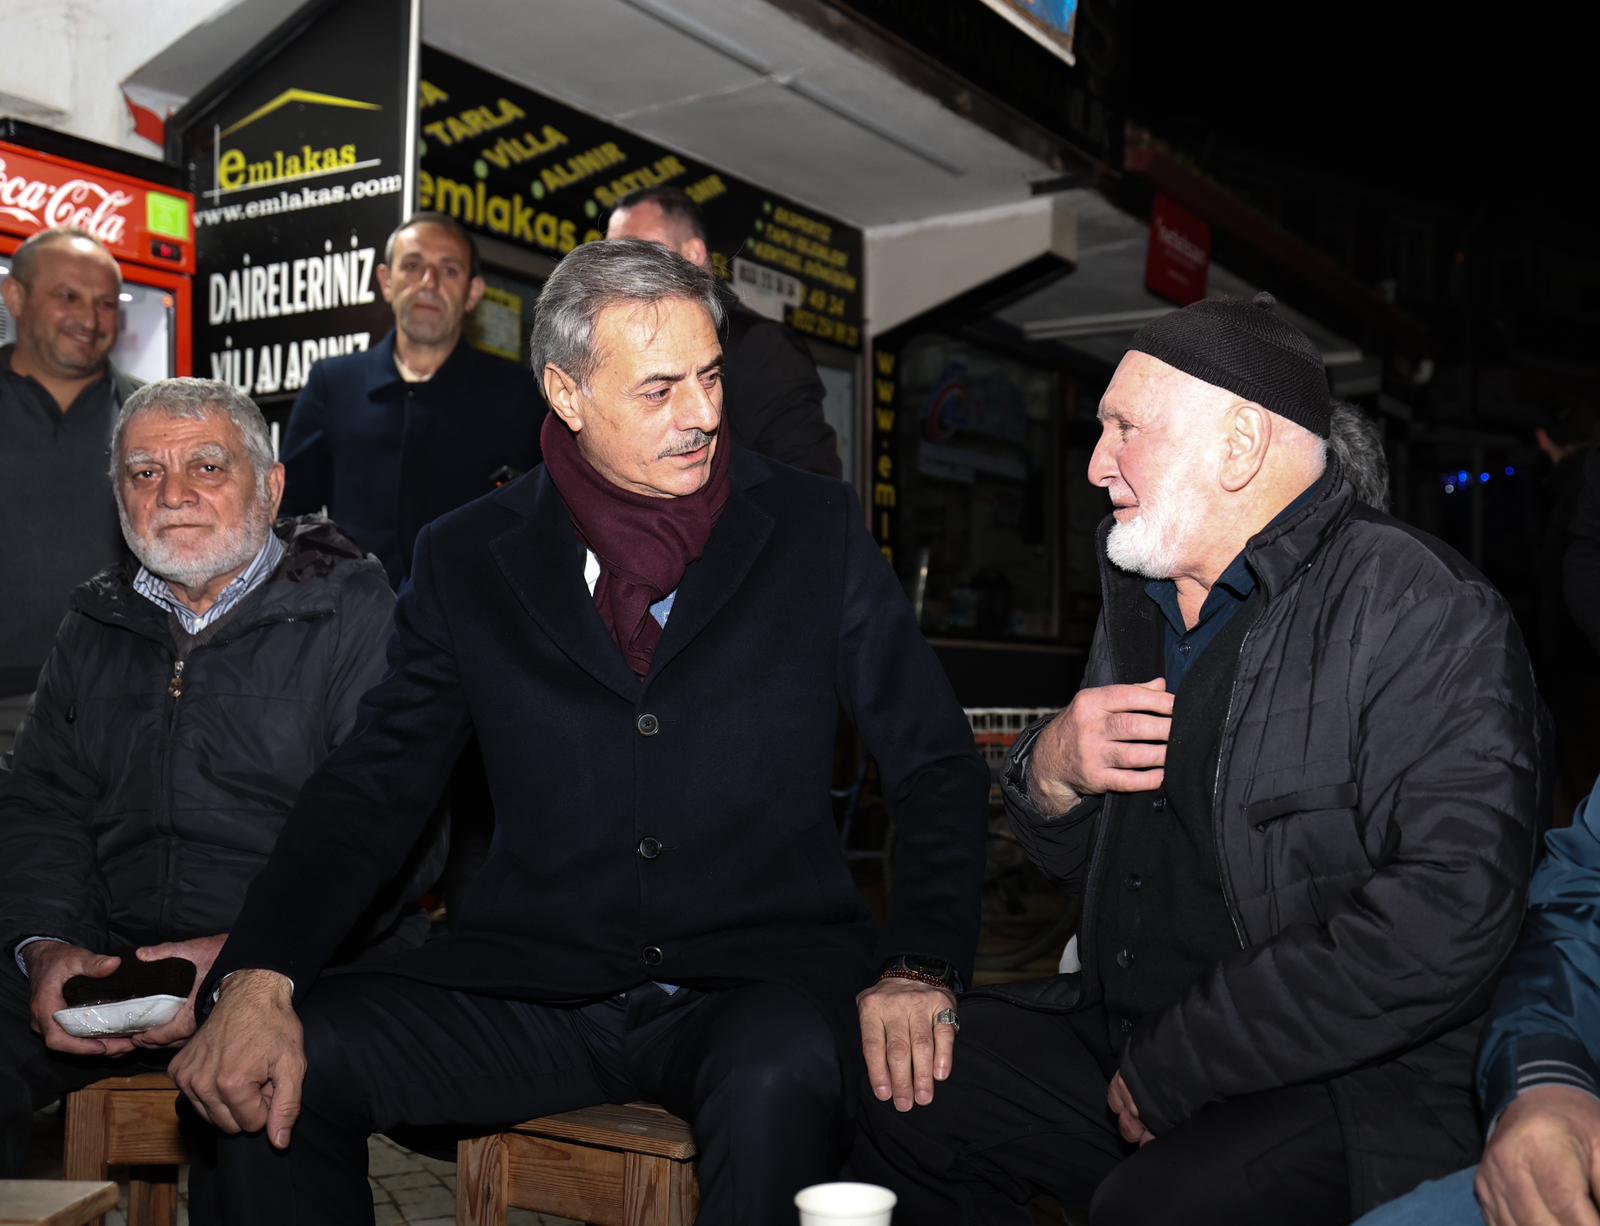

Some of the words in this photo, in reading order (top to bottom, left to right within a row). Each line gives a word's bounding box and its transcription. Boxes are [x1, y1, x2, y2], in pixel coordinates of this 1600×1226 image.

[423, 98, 525, 145] TARLA
[218, 143, 358, 190] emlakas
[481, 124, 569, 170] VİLLA
[539, 141, 628, 193] ALINIR
[0, 157, 134, 244] ca-Cola
[208, 234, 377, 326] DAİRELERİNİZ
